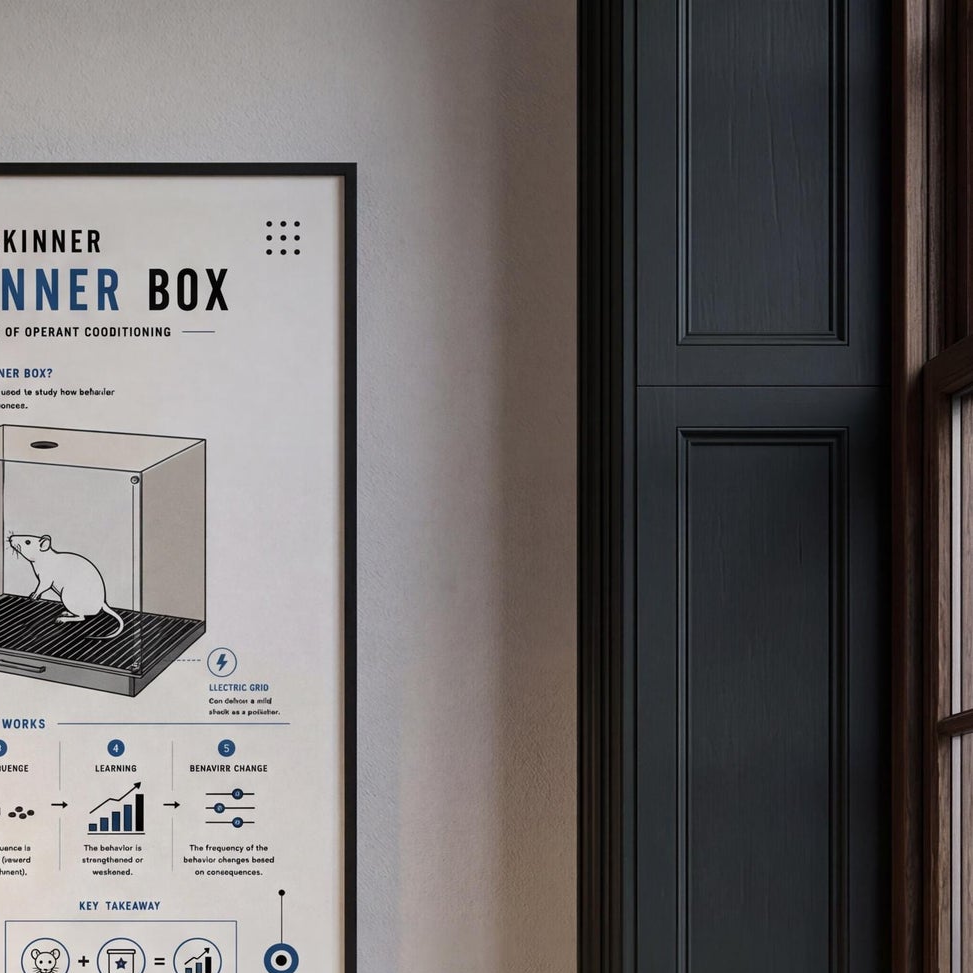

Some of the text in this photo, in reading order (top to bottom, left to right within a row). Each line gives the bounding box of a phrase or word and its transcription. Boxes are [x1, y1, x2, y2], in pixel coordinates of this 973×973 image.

[149, 268, 228, 311] BOX
[5, 327, 19, 337] OF
[25, 327, 79, 337] OPERANT
[85, 327, 171, 337] COODITIONING
[24, 368, 52, 378] BOX?
[35, 388, 57, 397] study
[60, 388, 77, 396] how
[2, 719, 45, 729] WORKS
[112, 743, 119, 753] 4
[223, 743, 230, 753] 5
[79, 901, 160, 910] KEY TAKEAWAY
